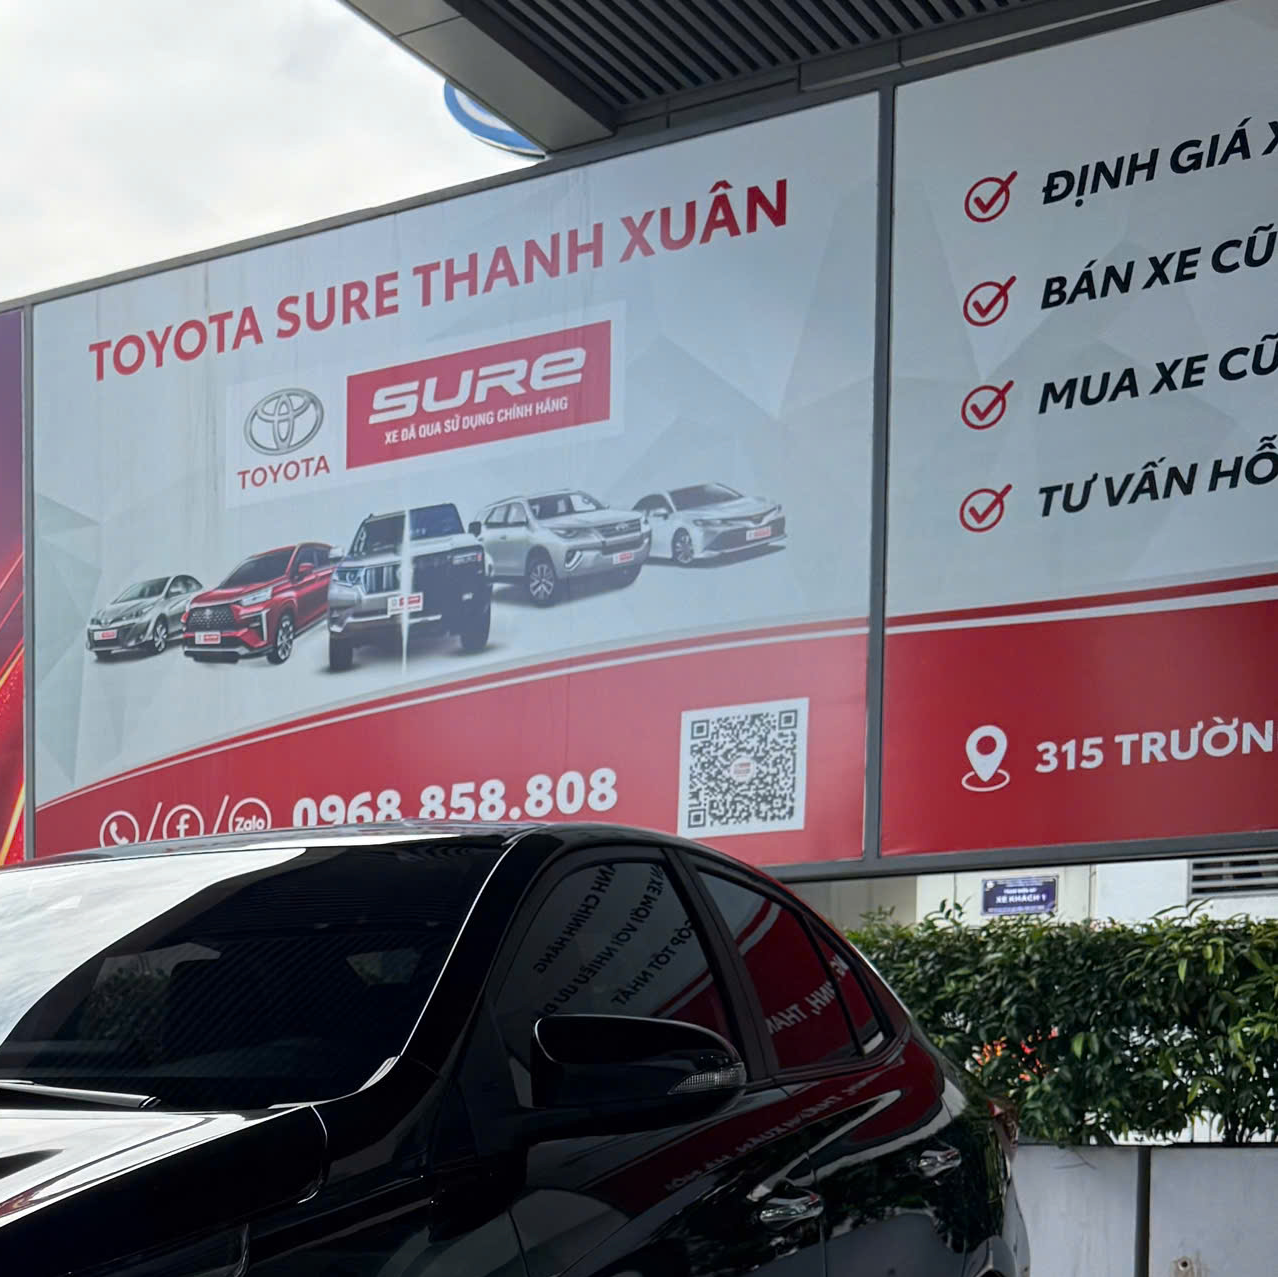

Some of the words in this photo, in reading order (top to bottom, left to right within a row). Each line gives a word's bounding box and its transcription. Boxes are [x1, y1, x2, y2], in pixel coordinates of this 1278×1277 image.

[1042, 148, 1160, 207] ĐỊNH
[1170, 116, 1252, 174] GIÁ
[89, 305, 264, 381] TOYOTA
[276, 271, 399, 339] SURE
[412, 222, 604, 307] THANH
[619, 178, 787, 263] XUÂN
[1041, 258, 1135, 310] BÁN
[1141, 246, 1202, 290] XE
[1211, 223, 1278, 274] CŨ
[1038, 367, 1139, 414] MUA
[1149, 353, 1209, 395] XE
[1219, 332, 1278, 381] CŨ
[384, 429, 398, 445] XE
[419, 421, 441, 439] QUA
[462, 411, 494, 431] DỤNG
[497, 404, 533, 422] CHÍNH
[536, 396, 569, 415] HÃNG
[237, 455, 330, 489] TOYOTA
[1038, 472, 1098, 517] TƯ
[1104, 456, 1198, 507] VẤN
[1208, 434, 1278, 492] HỖ
[1034, 736, 1104, 773] 315
[1114, 716, 1278, 766] TRƯỜN
[235, 814, 265, 832] Zalo
